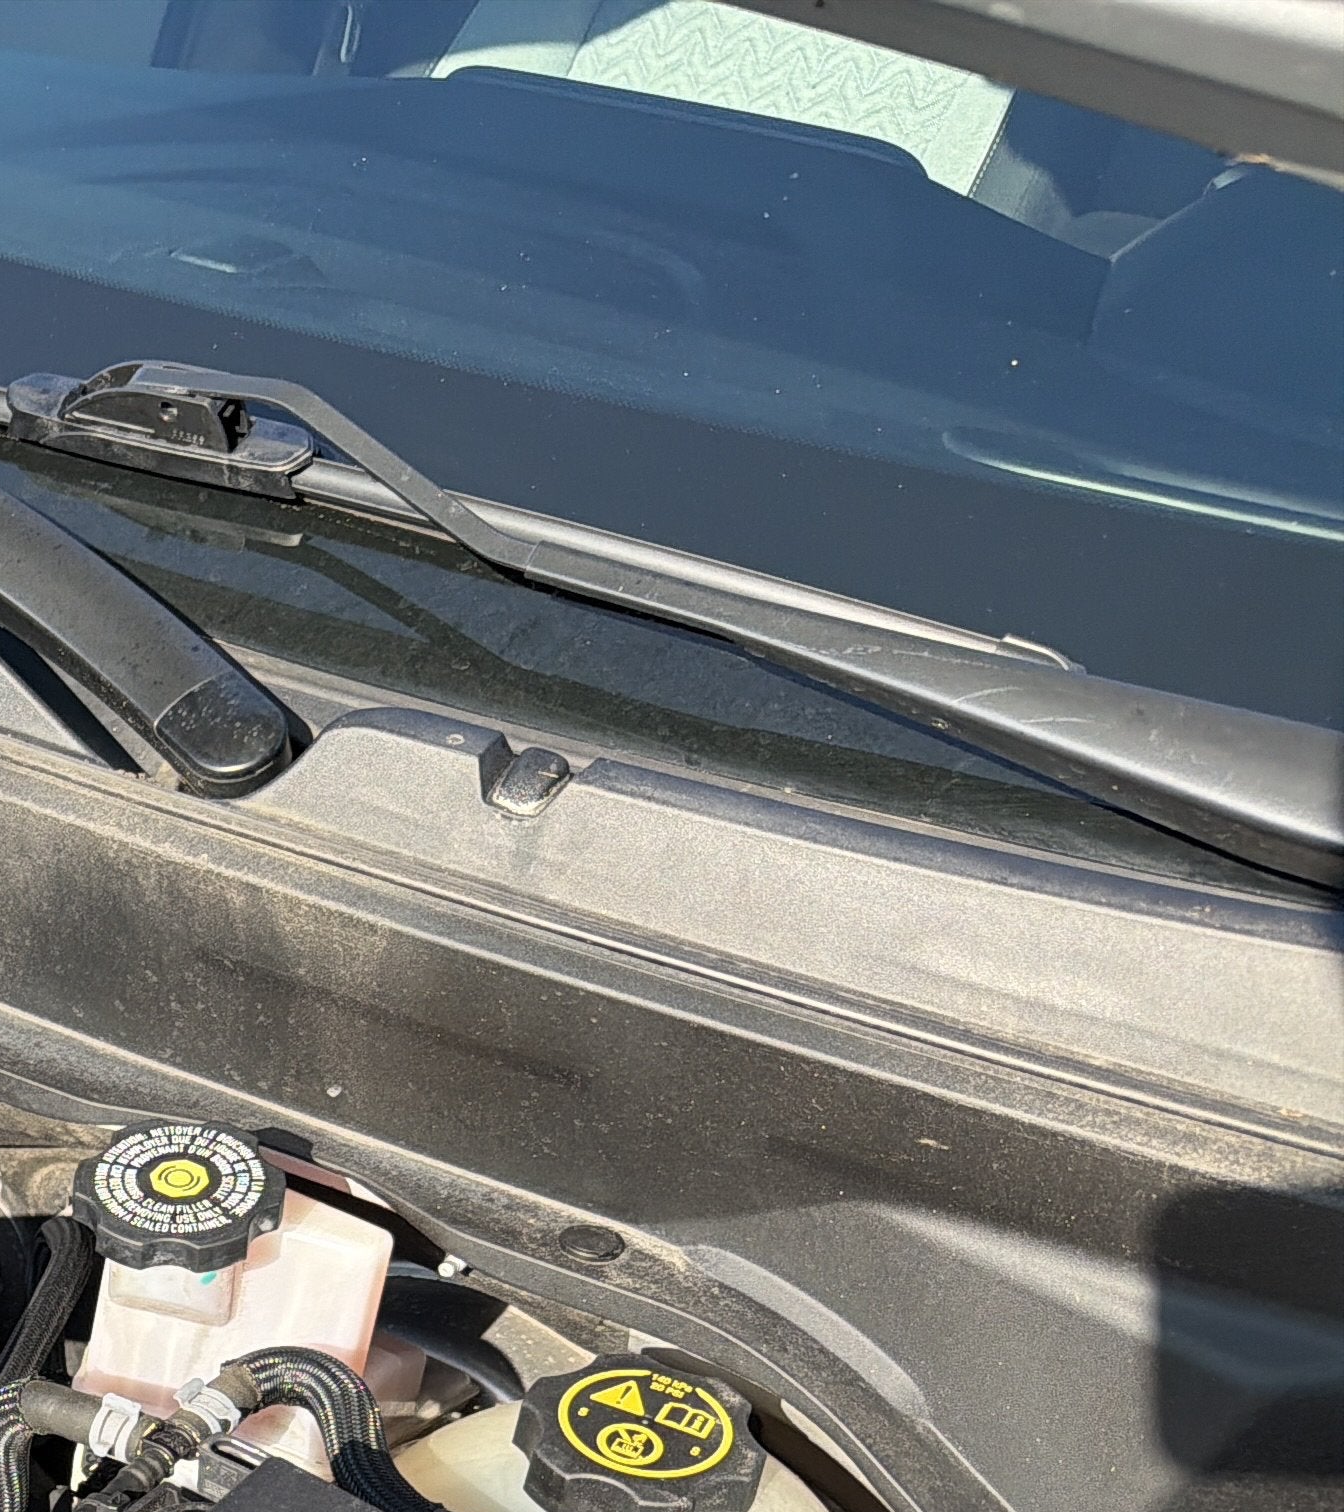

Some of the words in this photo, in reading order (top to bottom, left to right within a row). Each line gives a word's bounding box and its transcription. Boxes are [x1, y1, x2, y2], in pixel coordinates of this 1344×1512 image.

[150, 1126, 202, 1137] NETTOYER
[203, 1130, 217, 1140] LE
[171, 1135, 192, 1144] QUE
[194, 1136, 210, 1147] DU
[130, 1144, 185, 1168] PROVENANT
[188, 1145, 213, 1158] D'UN
[123, 1200, 173, 1223] REMOVING.
[176, 1213, 196, 1223] USE
[197, 1206, 223, 1222] ONLY
[142, 1198, 175, 1214] CLEAN
[176, 1199, 213, 1214] FILLER
[130, 1216, 169, 1233] SEALED
[171, 1215, 232, 1233] CONTAINER.
